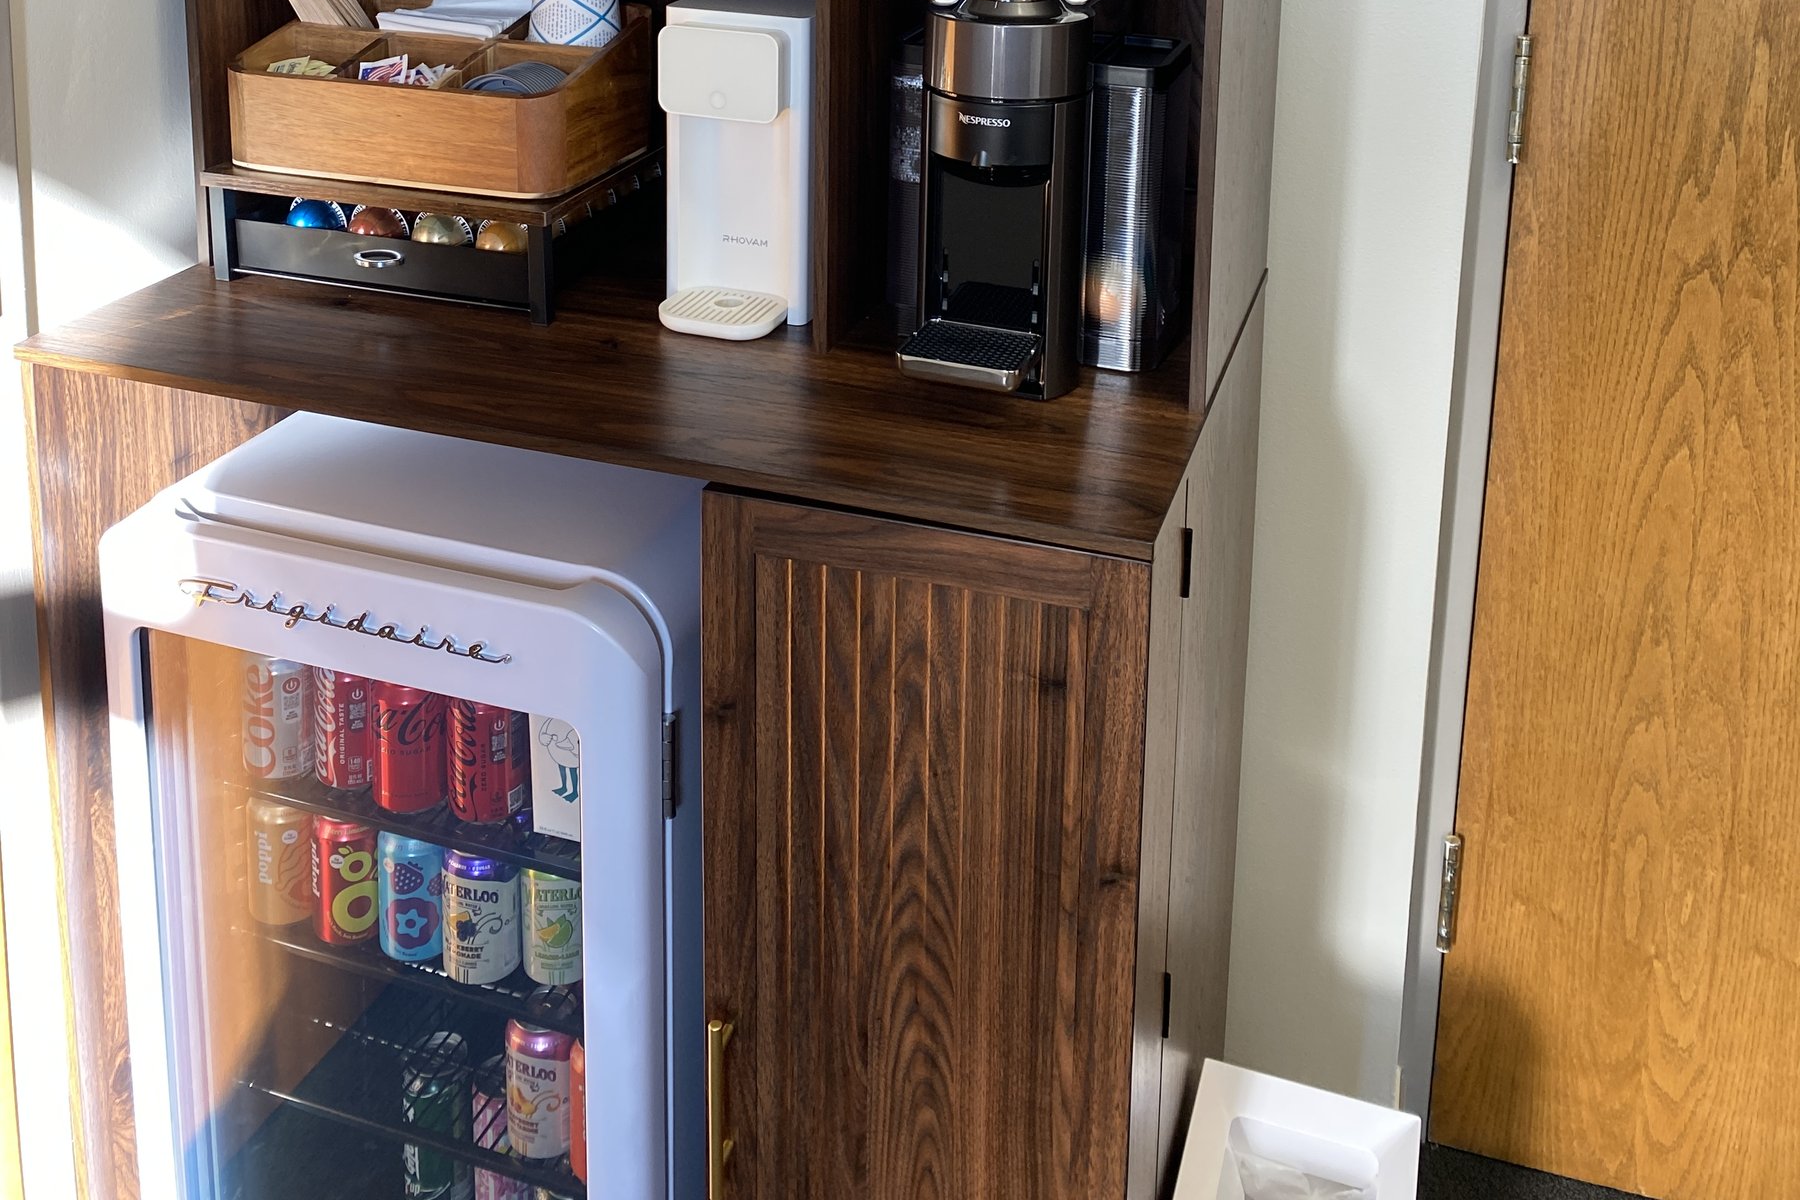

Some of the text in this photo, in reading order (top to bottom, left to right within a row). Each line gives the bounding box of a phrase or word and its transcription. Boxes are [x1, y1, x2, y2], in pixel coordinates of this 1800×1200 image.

[958, 111, 1011, 128] NESPRESSO
[722, 233, 768, 248] RHOVAM
[178, 576, 513, 665] Frigidaire
[242, 664, 276, 778] Coke
[338, 729, 346, 765] ORIGINAL
[255, 830, 273, 885] poppi
